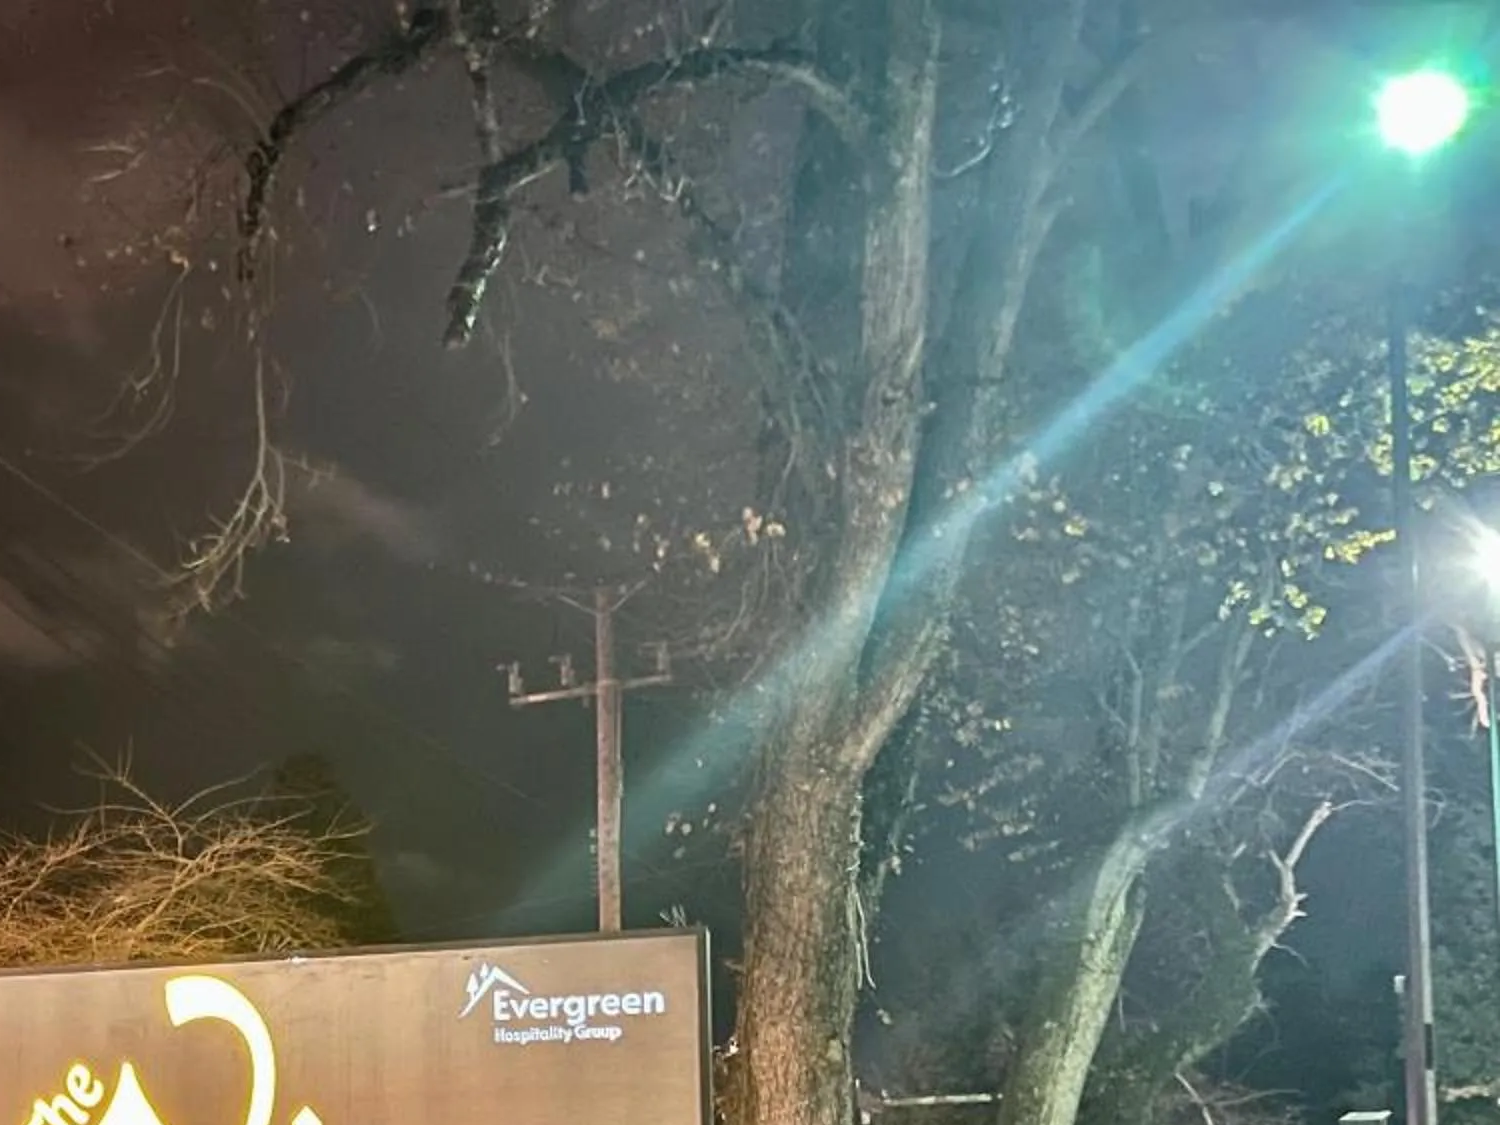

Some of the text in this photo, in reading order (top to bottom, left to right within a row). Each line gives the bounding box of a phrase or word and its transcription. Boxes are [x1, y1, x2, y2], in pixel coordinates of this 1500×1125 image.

[493, 991, 665, 1025] Evergreen
[494, 1023, 622, 1044] Hospitality Group
